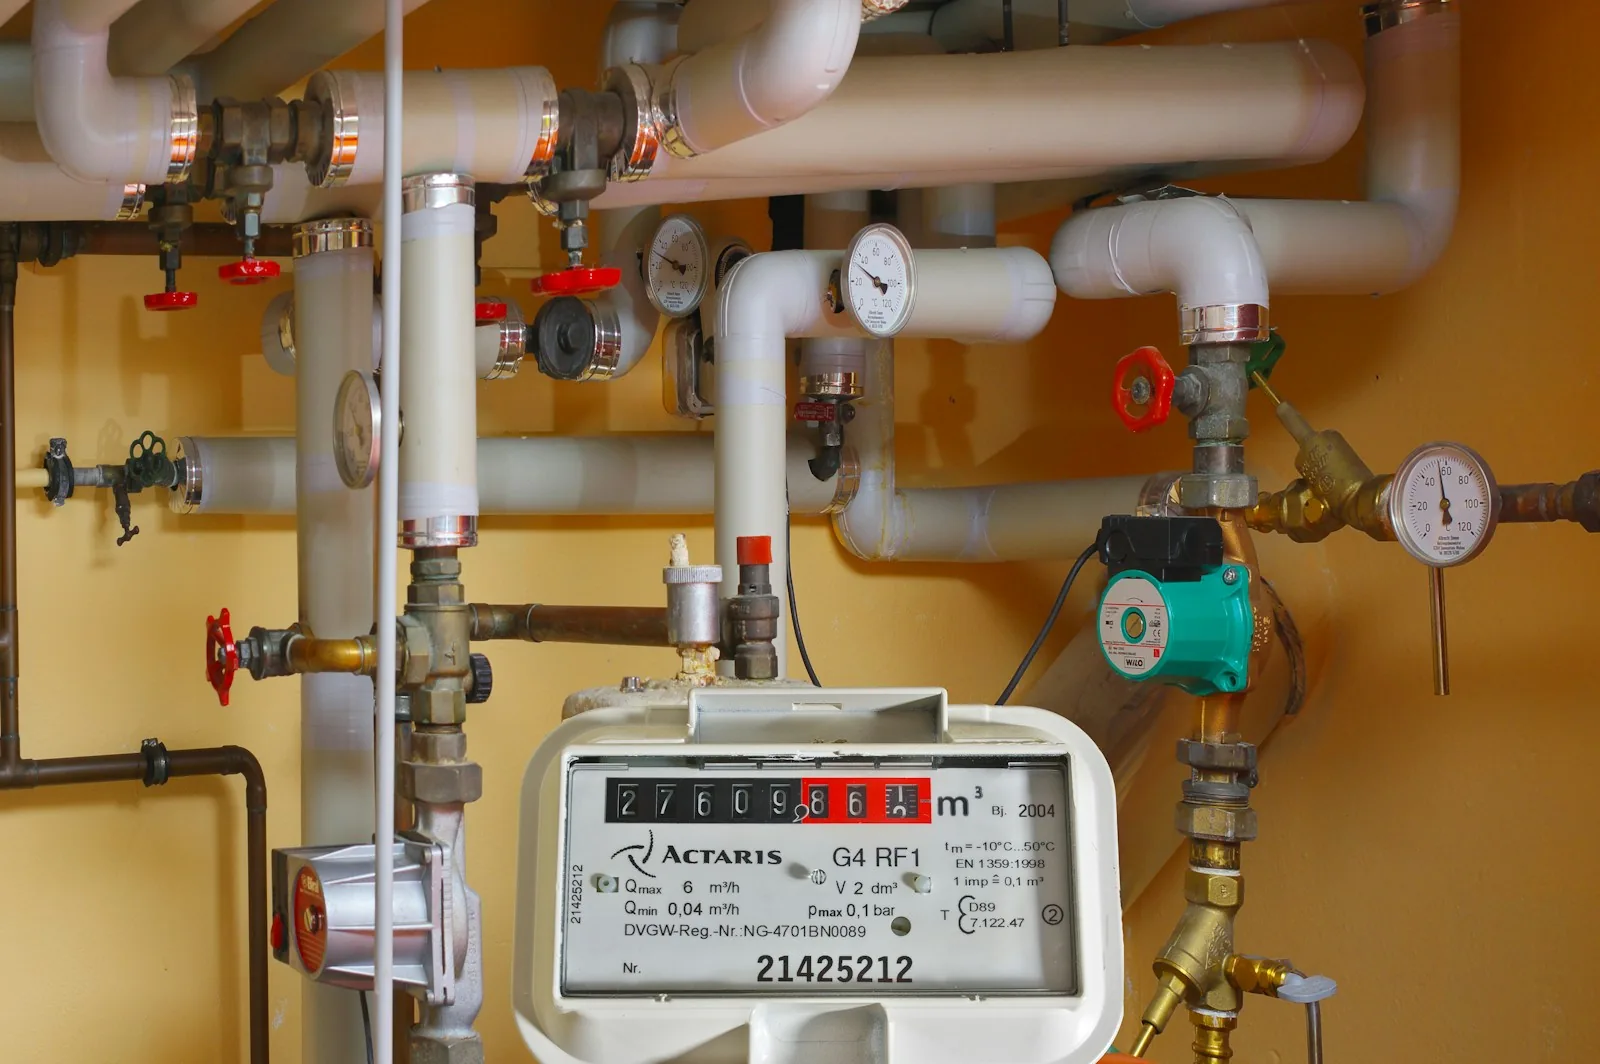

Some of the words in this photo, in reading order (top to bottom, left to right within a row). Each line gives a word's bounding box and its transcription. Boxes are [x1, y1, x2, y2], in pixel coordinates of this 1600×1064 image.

[1441, 466, 1452, 476] 60
[1425, 477, 1435, 487] 40
[1458, 475, 1469, 485] 80
[1417, 501, 1428, 511] 20
[1464, 499, 1479, 509] 100
[1425, 523, 1431, 533] 0
[1458, 522, 1472, 532] 120
[991, 805, 1008, 818] Bj.
[1018, 803, 1056, 818] 2004
[662, 845, 783, 865] ACTARIS
[832, 847, 866, 867] G4
[875, 847, 920, 867] RF1
[955, 859, 974, 869] EN
[978, 859, 1046, 869] 1359:1998
[625, 878, 662, 895] Qmax
[683, 880, 693, 894] 6
[835, 880, 847, 895] V
[854, 882, 864, 895] 2
[953, 877, 959, 887] 1
[964, 876, 989, 889] imp
[1004, 876, 1021, 888] 0,1
[570, 864, 584, 924] 21425212
[624, 899, 658, 917] Qmin
[667, 902, 703, 918] 0,04
[808, 904, 843, 919] pmax
[846, 903, 869, 919] 0,1
[873, 903, 896, 917] bar
[969, 902, 996, 912] D89
[940, 909, 950, 921] T
[970, 918, 1025, 928] 7.122.47
[622, 962, 642, 974] Nr.
[756, 955, 914, 983] 21425212
